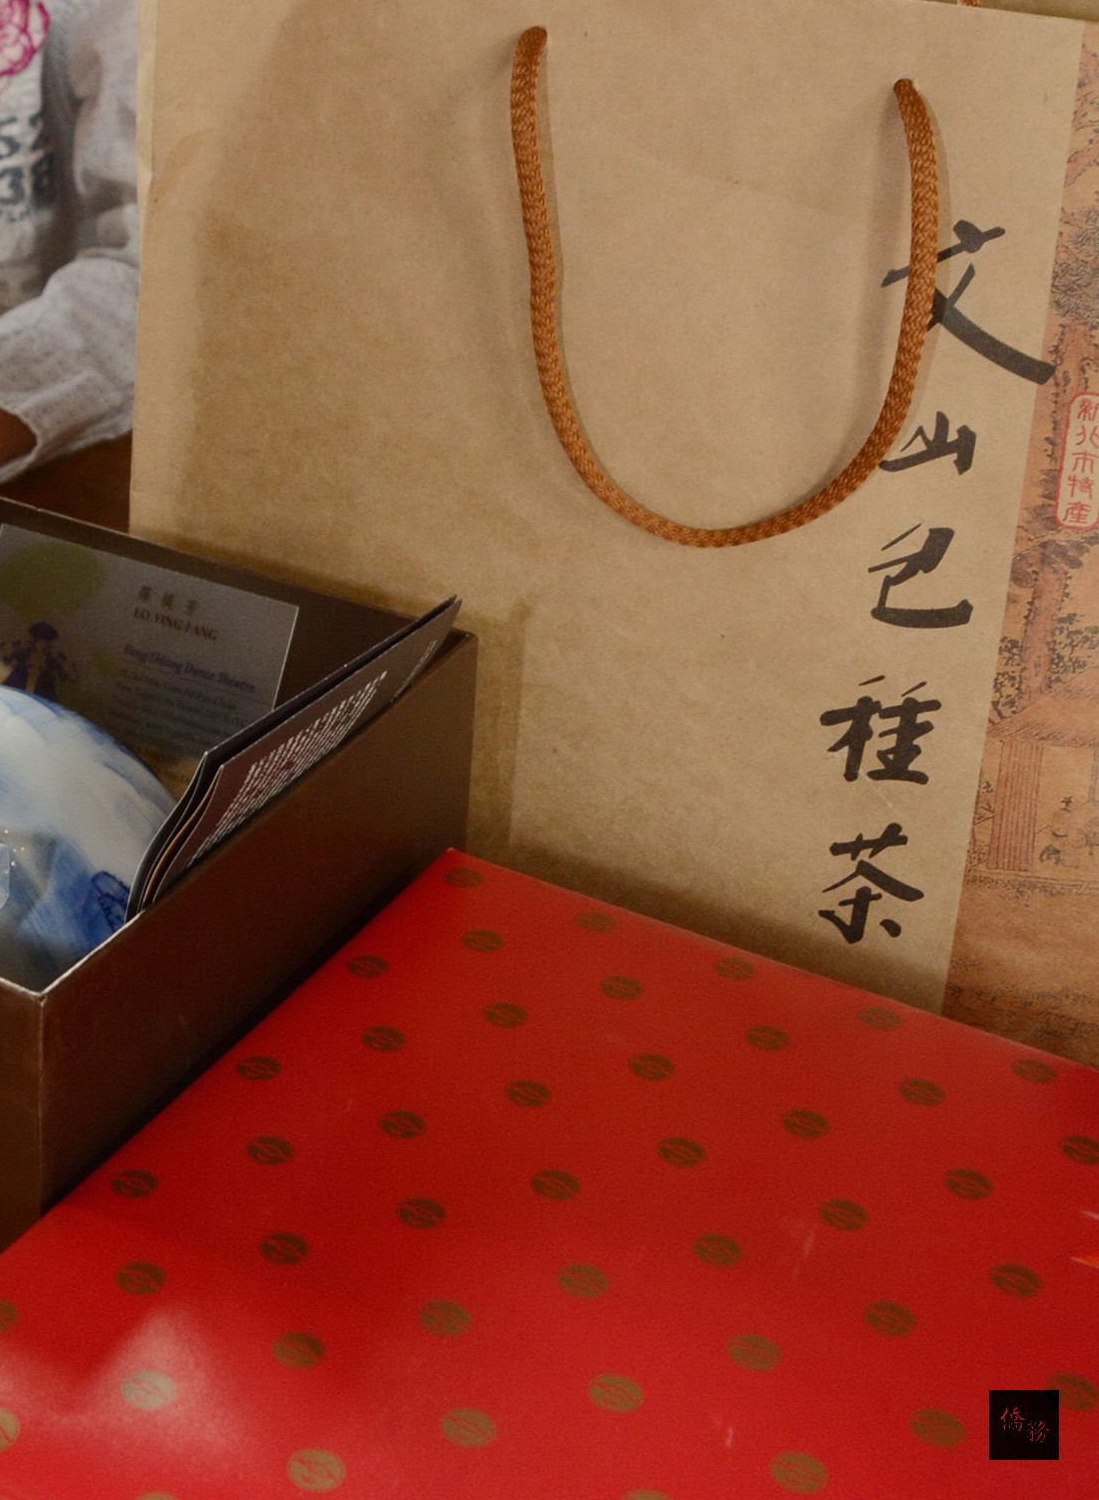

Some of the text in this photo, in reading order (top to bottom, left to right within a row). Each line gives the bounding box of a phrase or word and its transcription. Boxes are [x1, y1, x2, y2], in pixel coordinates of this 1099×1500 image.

[819, 219, 1055, 944] 文山包種茶
